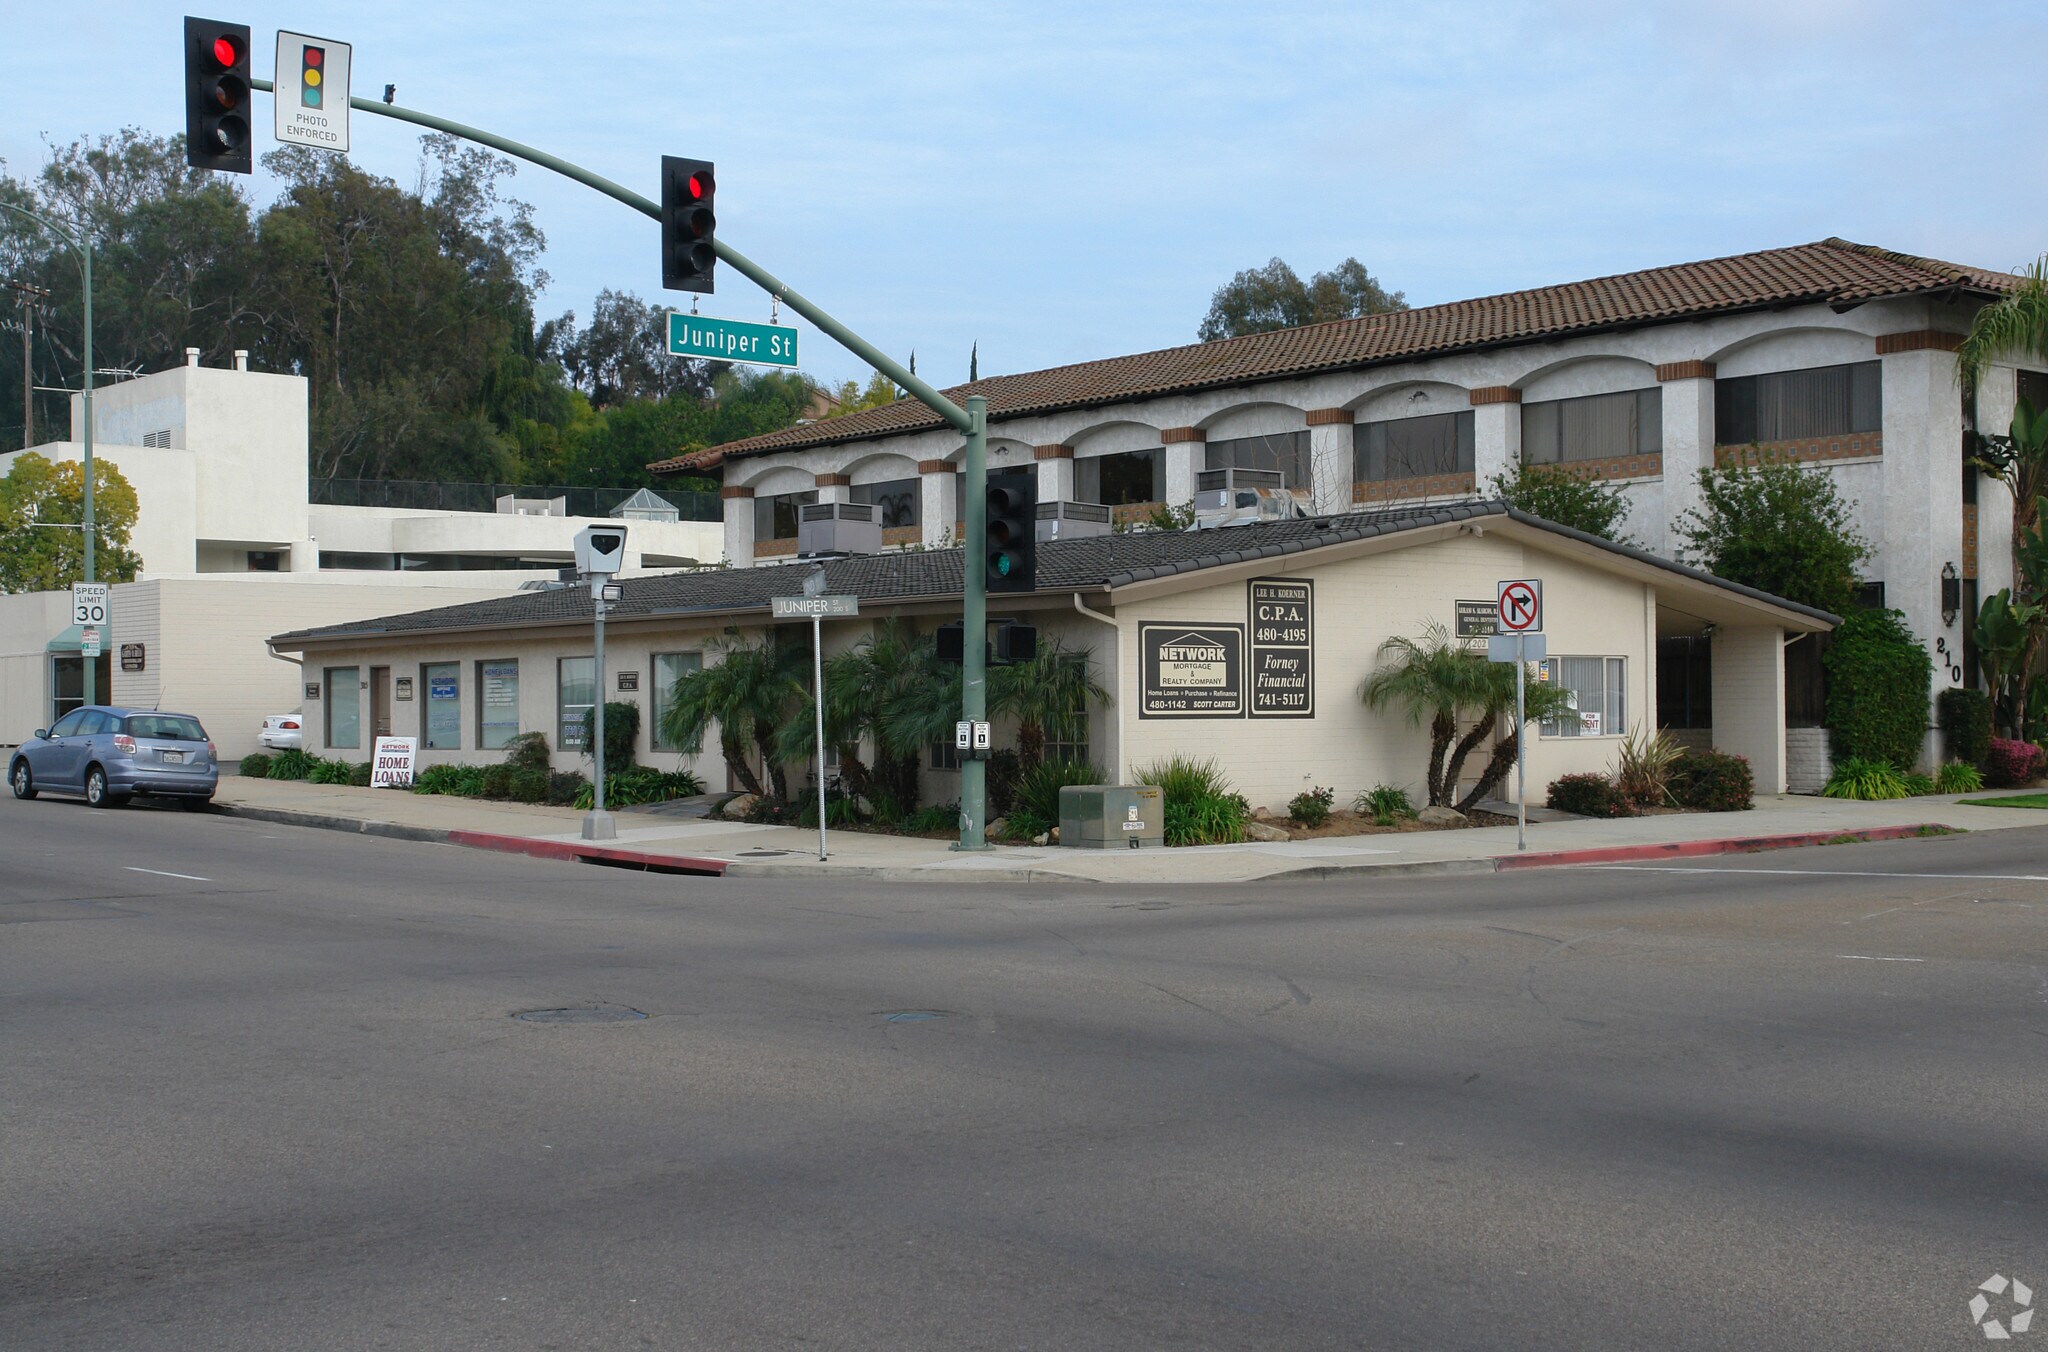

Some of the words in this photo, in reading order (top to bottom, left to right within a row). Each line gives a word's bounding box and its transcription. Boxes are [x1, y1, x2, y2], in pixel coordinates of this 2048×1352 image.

[296, 113, 328, 127] PHOTO
[286, 125, 338, 142] ENFORCED
[678, 324, 759, 355] Juniper
[770, 334, 791, 357] St
[75, 587, 106, 595] SPEED
[1256, 588, 1268, 598] LEE
[1269, 588, 1277, 599] H.
[1278, 589, 1306, 600] KOERNER
[79, 596, 102, 604] LIMIT
[778, 600, 829, 614] JUNIPER
[76, 605, 104, 622] 30
[1259, 605, 1304, 622] C.P.A.
[1256, 627, 1306, 642] 480-4195
[1472, 639, 1487, 648] 202
[1160, 647, 1226, 661] NETWORK
[1936, 636, 1961, 682] 210
[1264, 654, 1299, 672] Forney
[1162, 677, 1187, 685] REALTY
[1257, 672, 1306, 688] Financial
[1149, 700, 1187, 709] 480-1142
[1193, 700, 1213, 708] SCOTT
[1213, 700, 1236, 708] CARTER
[1258, 693, 1304, 706] 741-5117
[378, 756, 410, 769] HOME
[373, 770, 410, 784] LOANS
